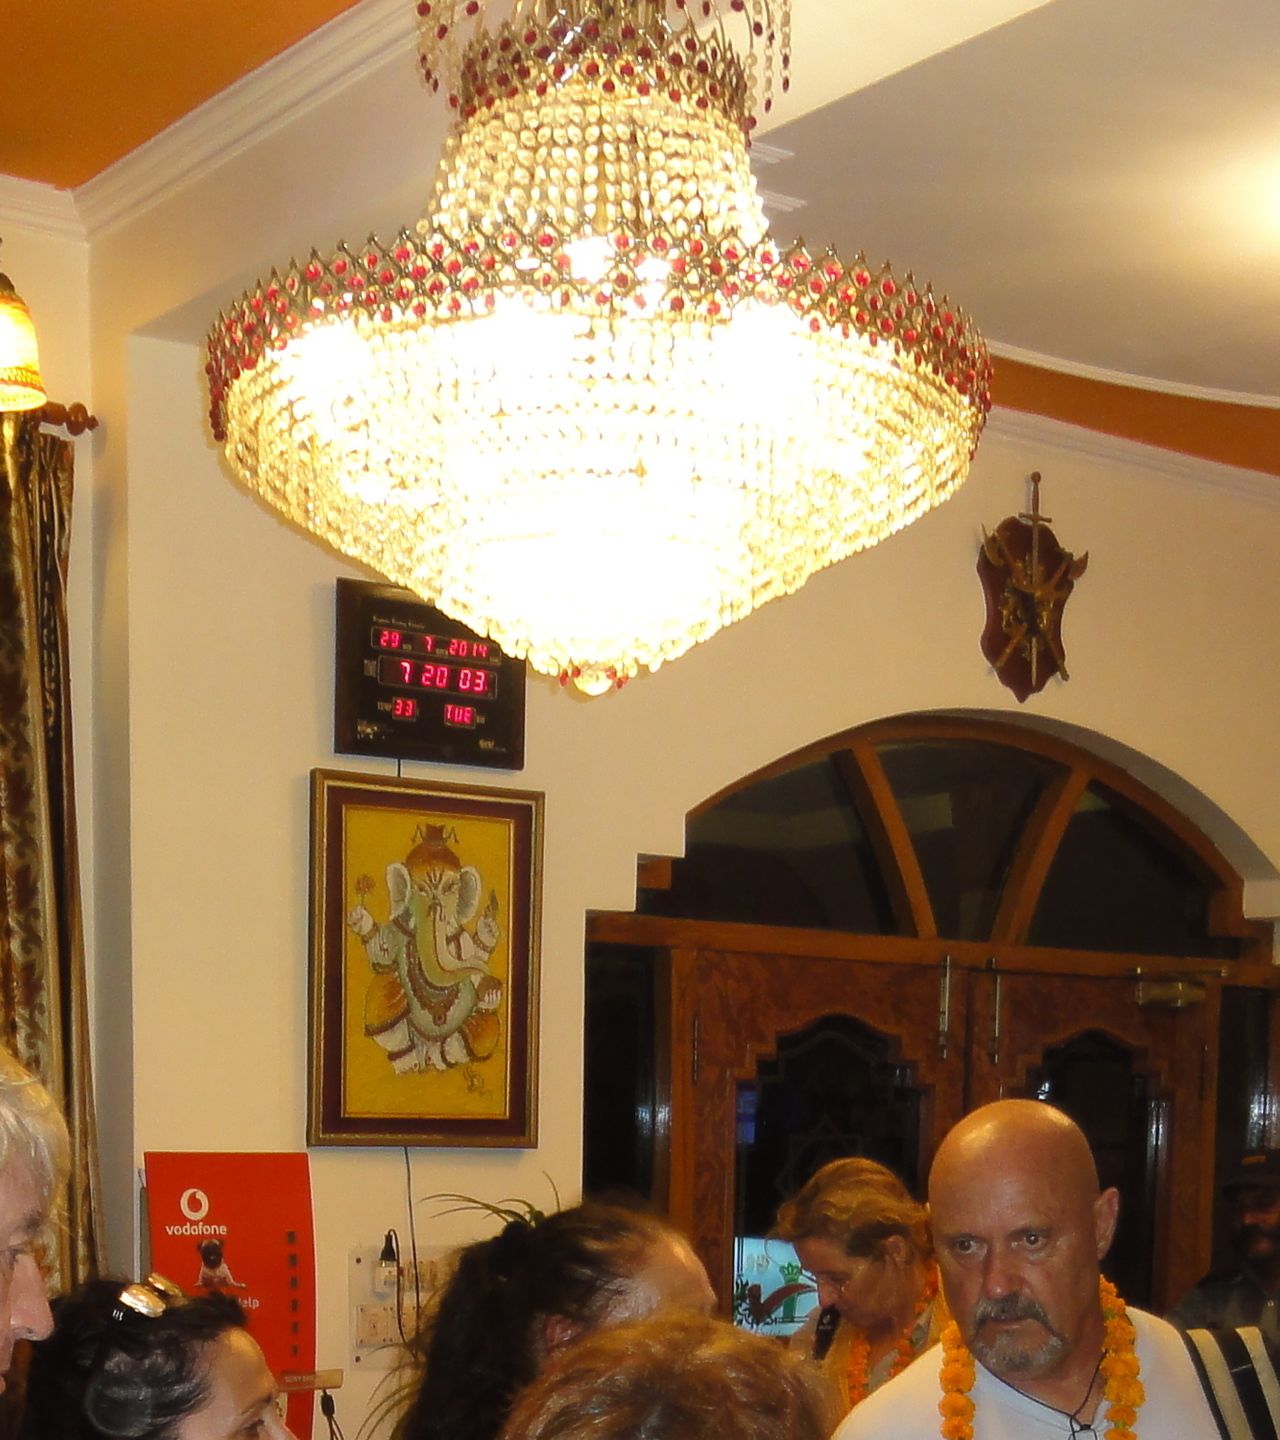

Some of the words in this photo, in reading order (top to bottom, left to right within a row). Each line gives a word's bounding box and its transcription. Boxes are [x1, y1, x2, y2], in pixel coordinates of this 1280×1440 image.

[380, 631, 400, 647] 29
[425, 636, 432, 652] 7
[449, 639, 487, 658] 2014
[401, 662, 411, 684] 7
[421, 664, 448, 688] 20
[459, 669, 485, 692] 03
[395, 699, 413, 716] 33
[447, 704, 471, 723] TUE
[165, 1222, 228, 1236] vodafone
